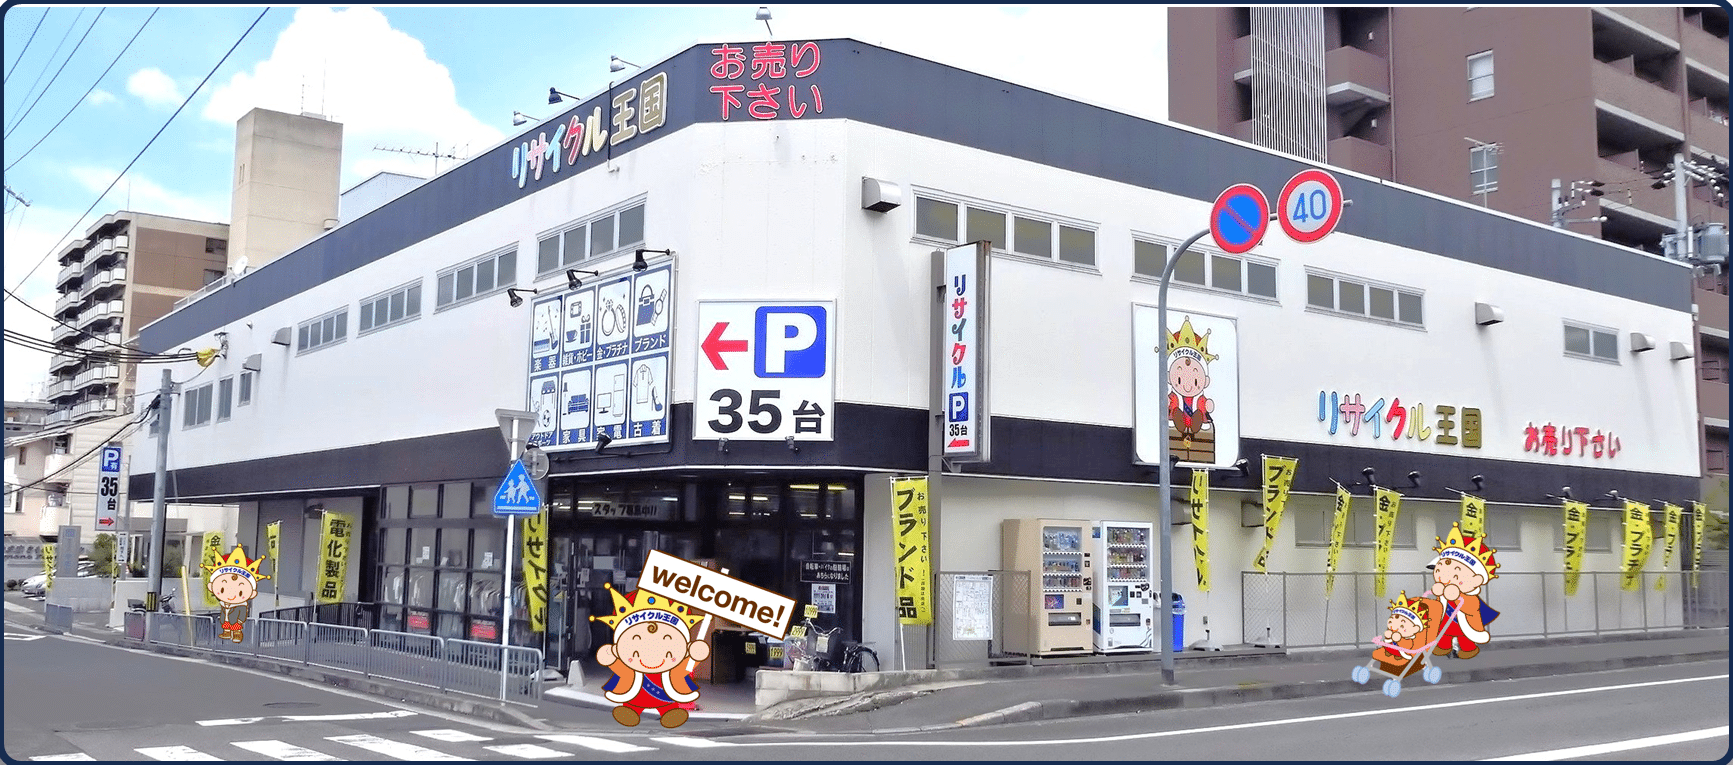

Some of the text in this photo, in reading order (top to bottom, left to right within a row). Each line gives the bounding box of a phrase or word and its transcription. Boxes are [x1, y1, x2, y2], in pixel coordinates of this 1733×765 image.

[711, 41, 821, 80] お売り
[710, 83, 823, 121] 下さい
[511, 71, 668, 189] リサイクル王国
[1293, 189, 1327, 223] 40
[634, 333, 667, 353] ブランド
[764, 312, 818, 374] P
[950, 273, 969, 390] リサイクル
[596, 341, 629, 361] 金・プラチナ
[951, 395, 966, 420] P
[1318, 390, 1483, 449] リサイクル王国
[562, 428, 587, 445] 家具
[633, 419, 661, 438] 古着
[949, 423, 968, 437] 35台
[1524, 421, 1622, 458] お売り下さい
[321, 519, 346, 599] 電化製品
[896, 487, 918, 619] ブランド品
